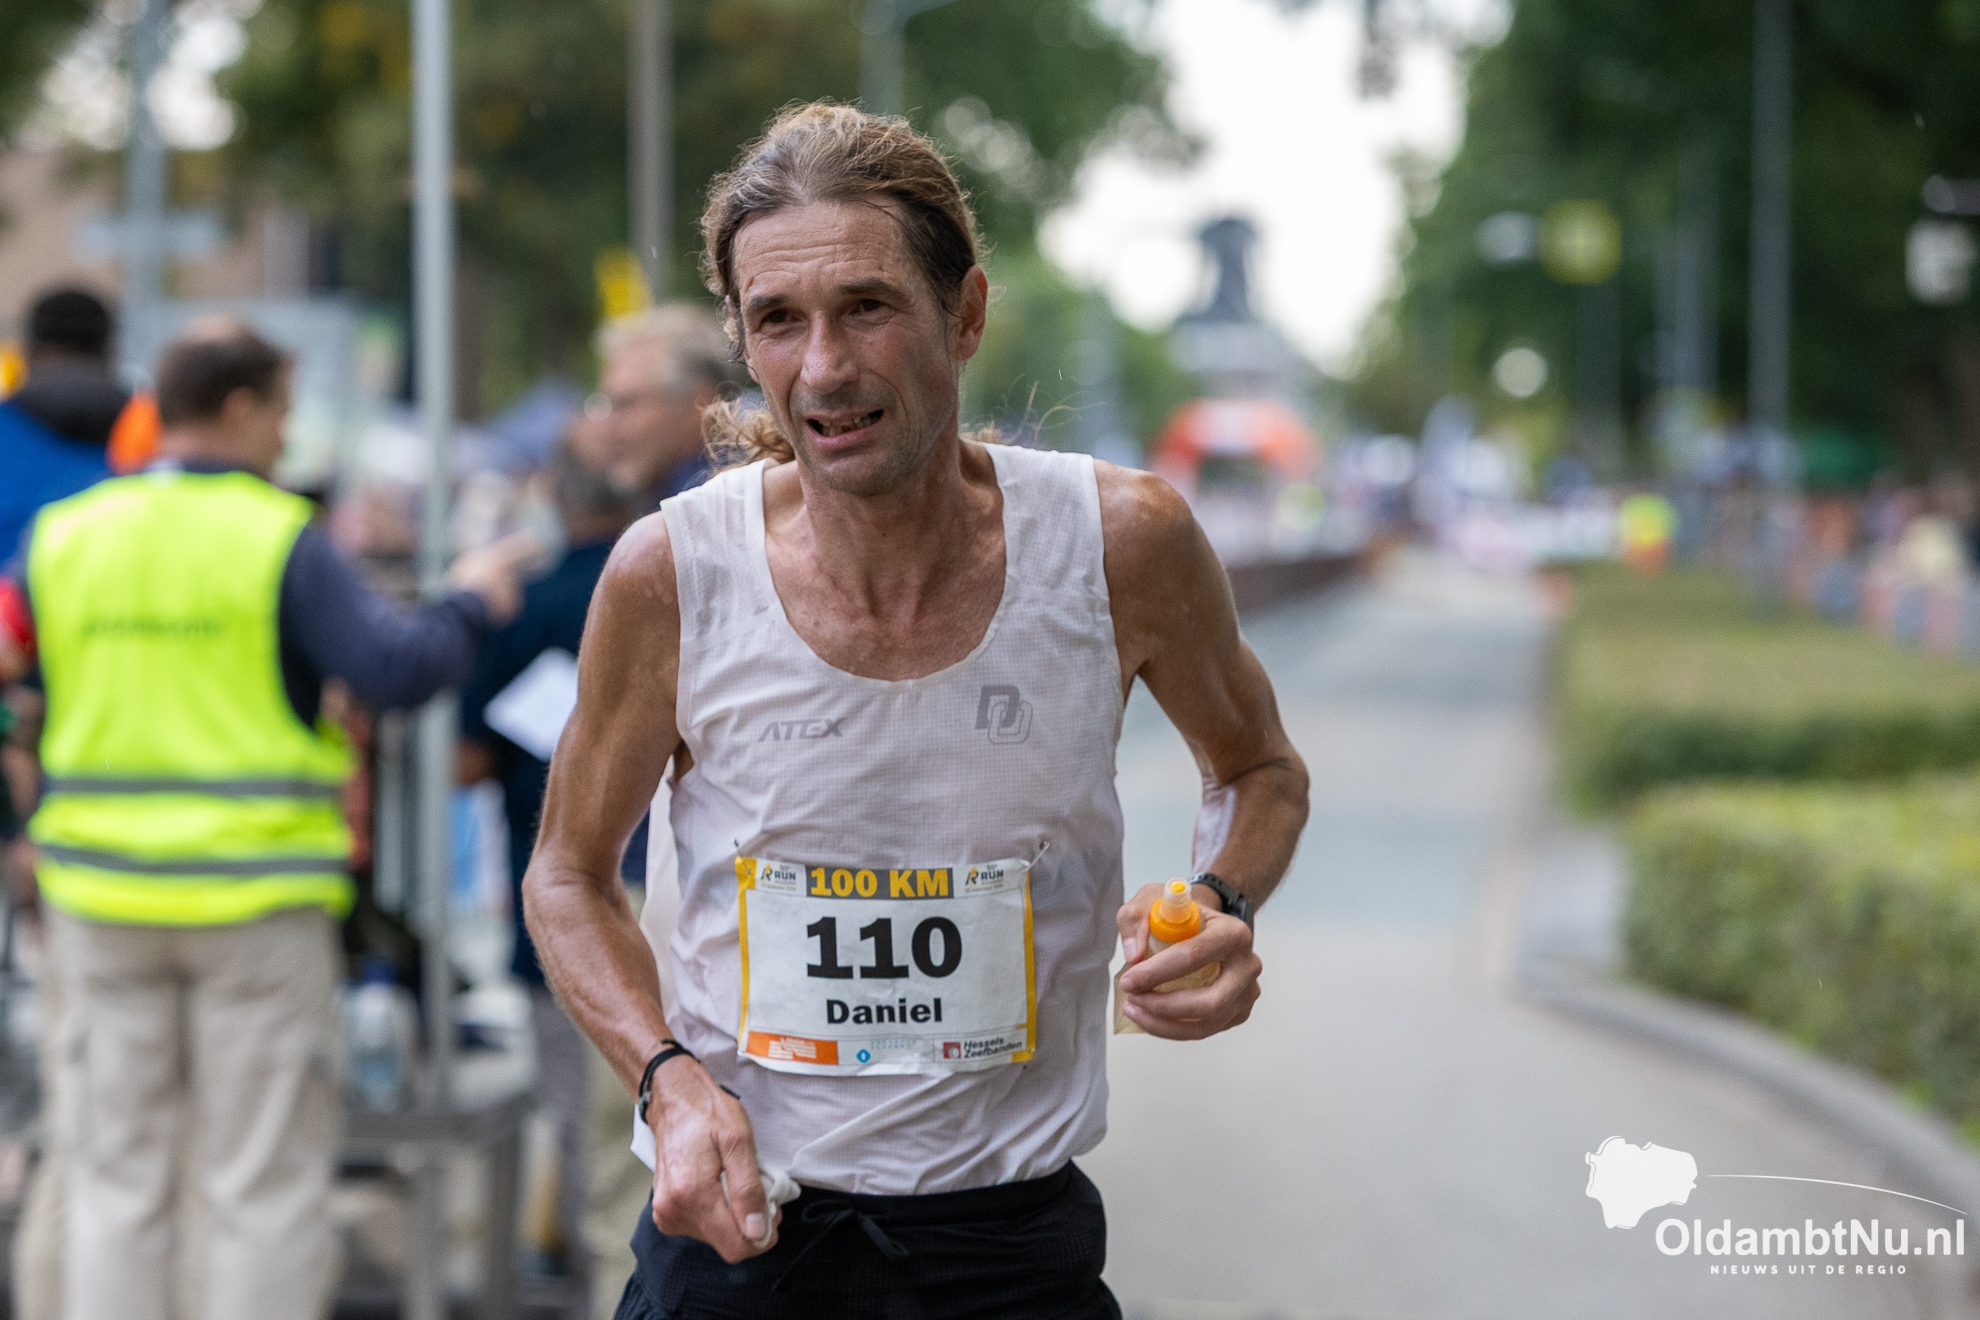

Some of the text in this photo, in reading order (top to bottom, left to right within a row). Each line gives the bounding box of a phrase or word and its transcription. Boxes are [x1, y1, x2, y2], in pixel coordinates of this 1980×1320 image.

[758, 717, 847, 743] ATEX
[774, 870, 796, 881] RUN
[810, 867, 950, 898] 100 KM
[981, 869, 1004, 881] RUN
[806, 916, 963, 980] 110
[826, 997, 943, 1025] Daniel
[963, 1037, 1004, 1050] Hessels
